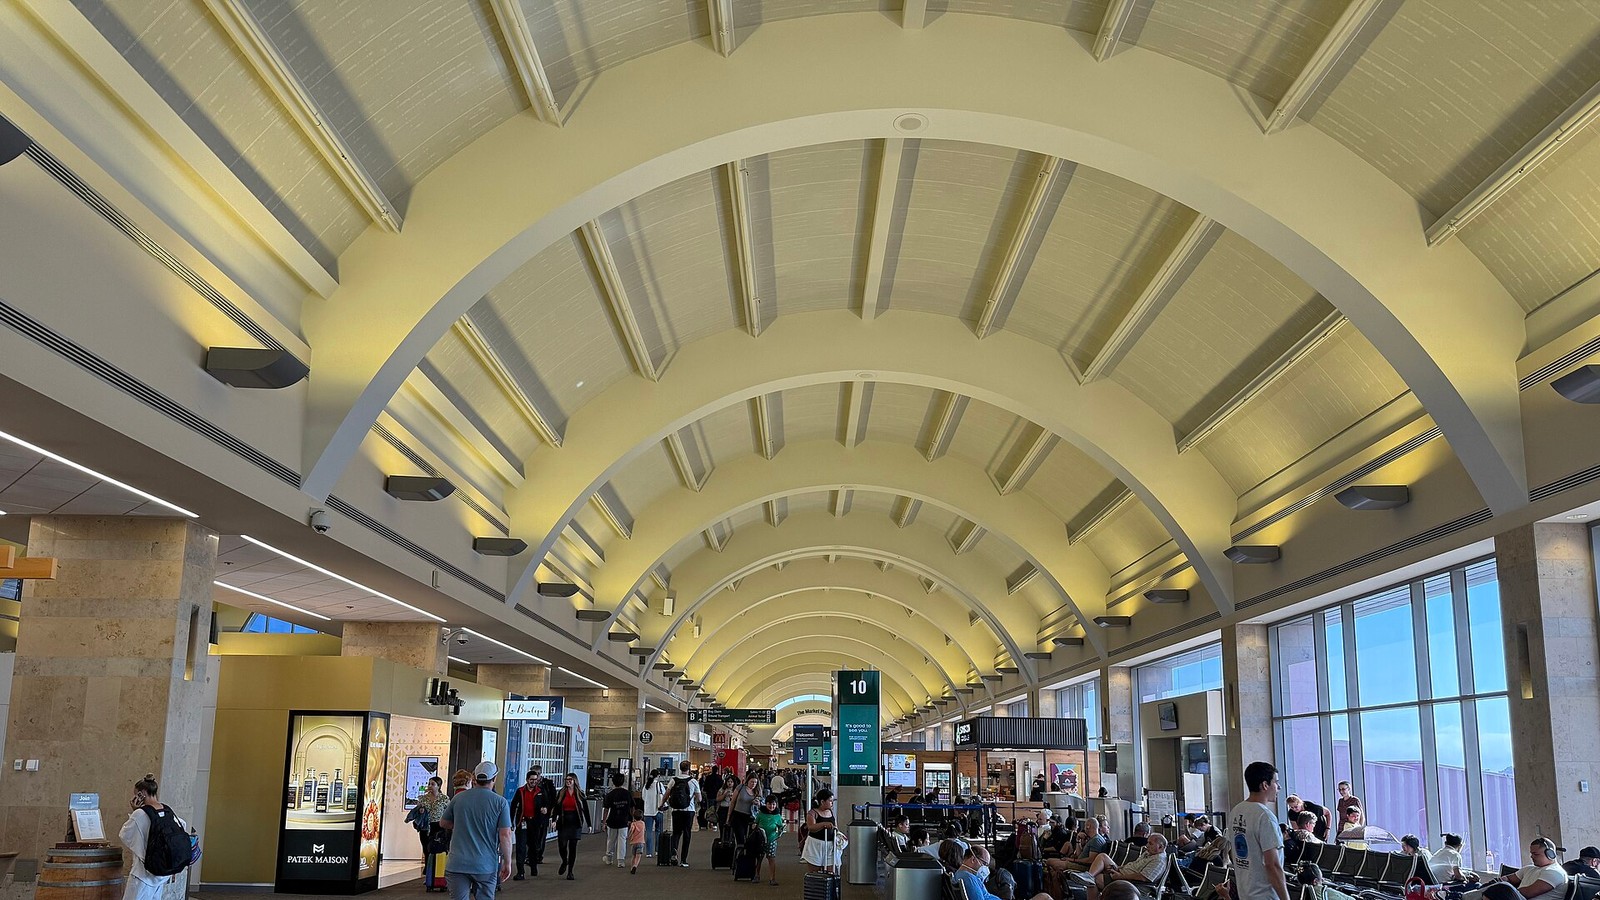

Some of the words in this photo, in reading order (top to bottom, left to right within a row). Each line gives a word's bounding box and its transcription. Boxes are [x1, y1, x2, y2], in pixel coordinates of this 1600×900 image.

[850, 680, 868, 694] 10
[516, 703, 547, 717] Boutique
[823, 730, 830, 738] 11
[575, 735, 585, 757] hoag
[287, 856, 314, 864] PATEK
[315, 856, 349, 864] MAISON
